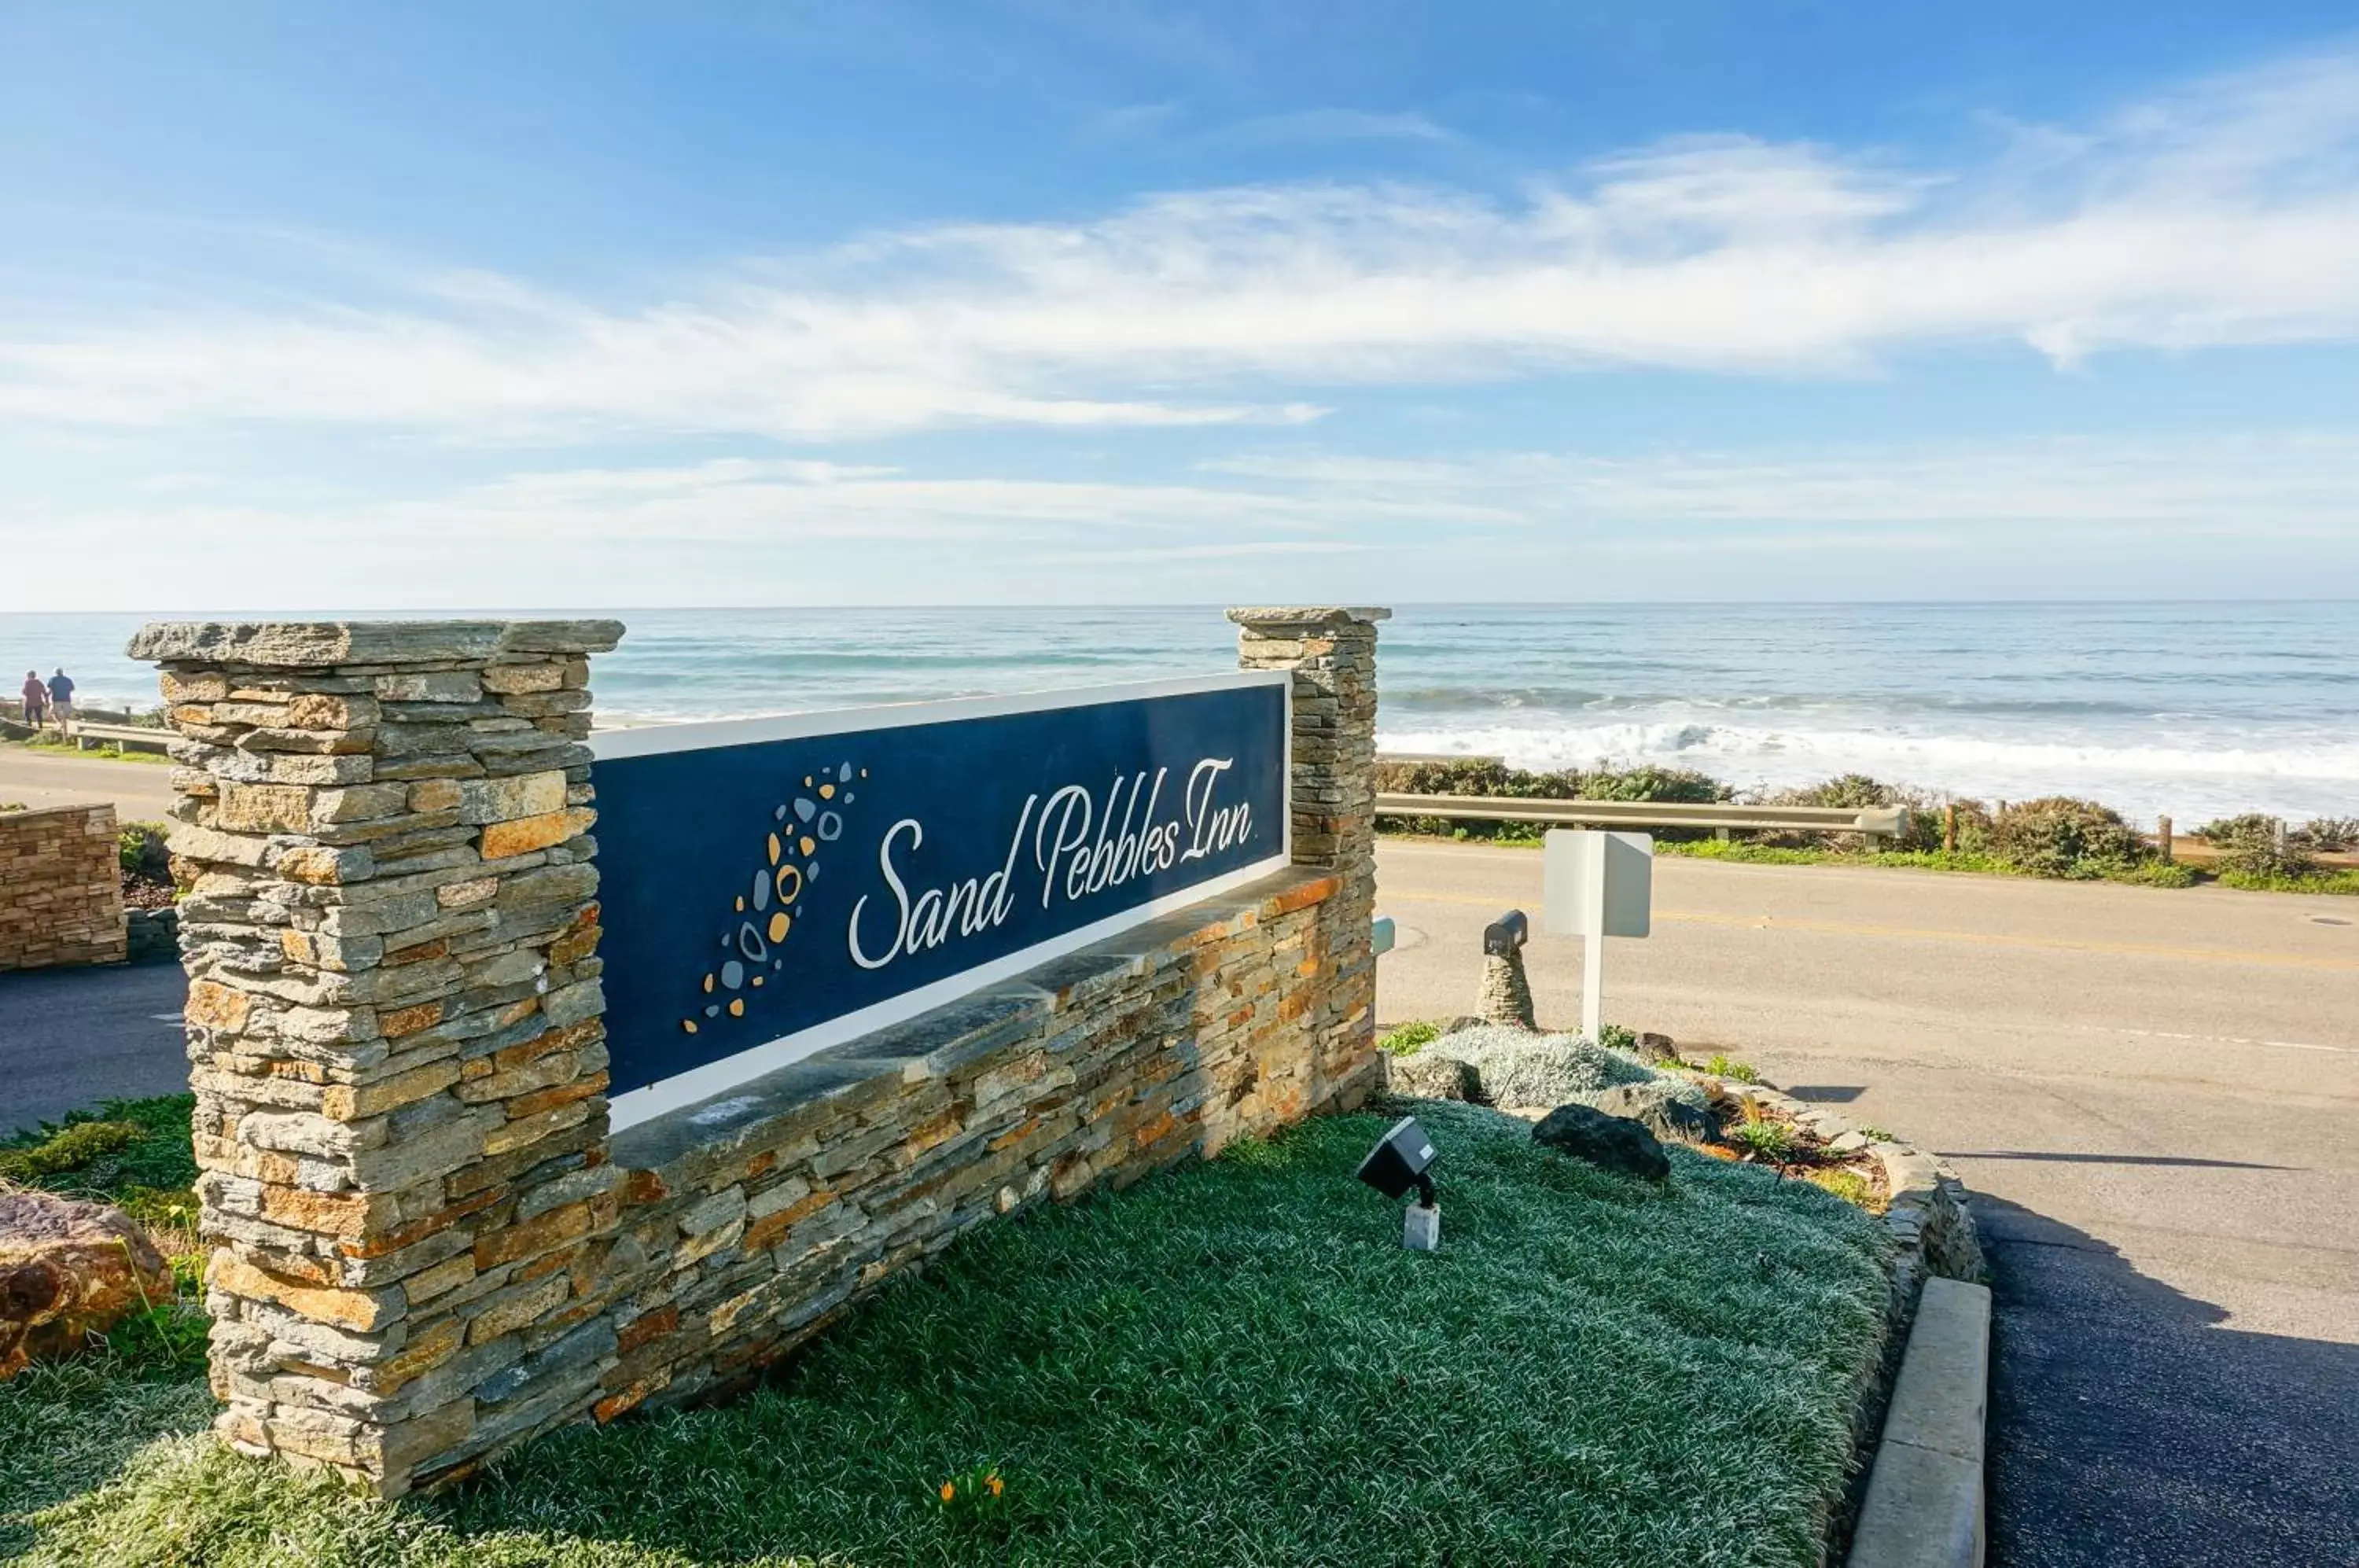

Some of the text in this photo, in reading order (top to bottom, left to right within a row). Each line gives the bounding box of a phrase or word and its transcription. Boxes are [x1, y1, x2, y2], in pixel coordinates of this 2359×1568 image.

[849, 757, 1253, 969] Sand Pebbles Inn
